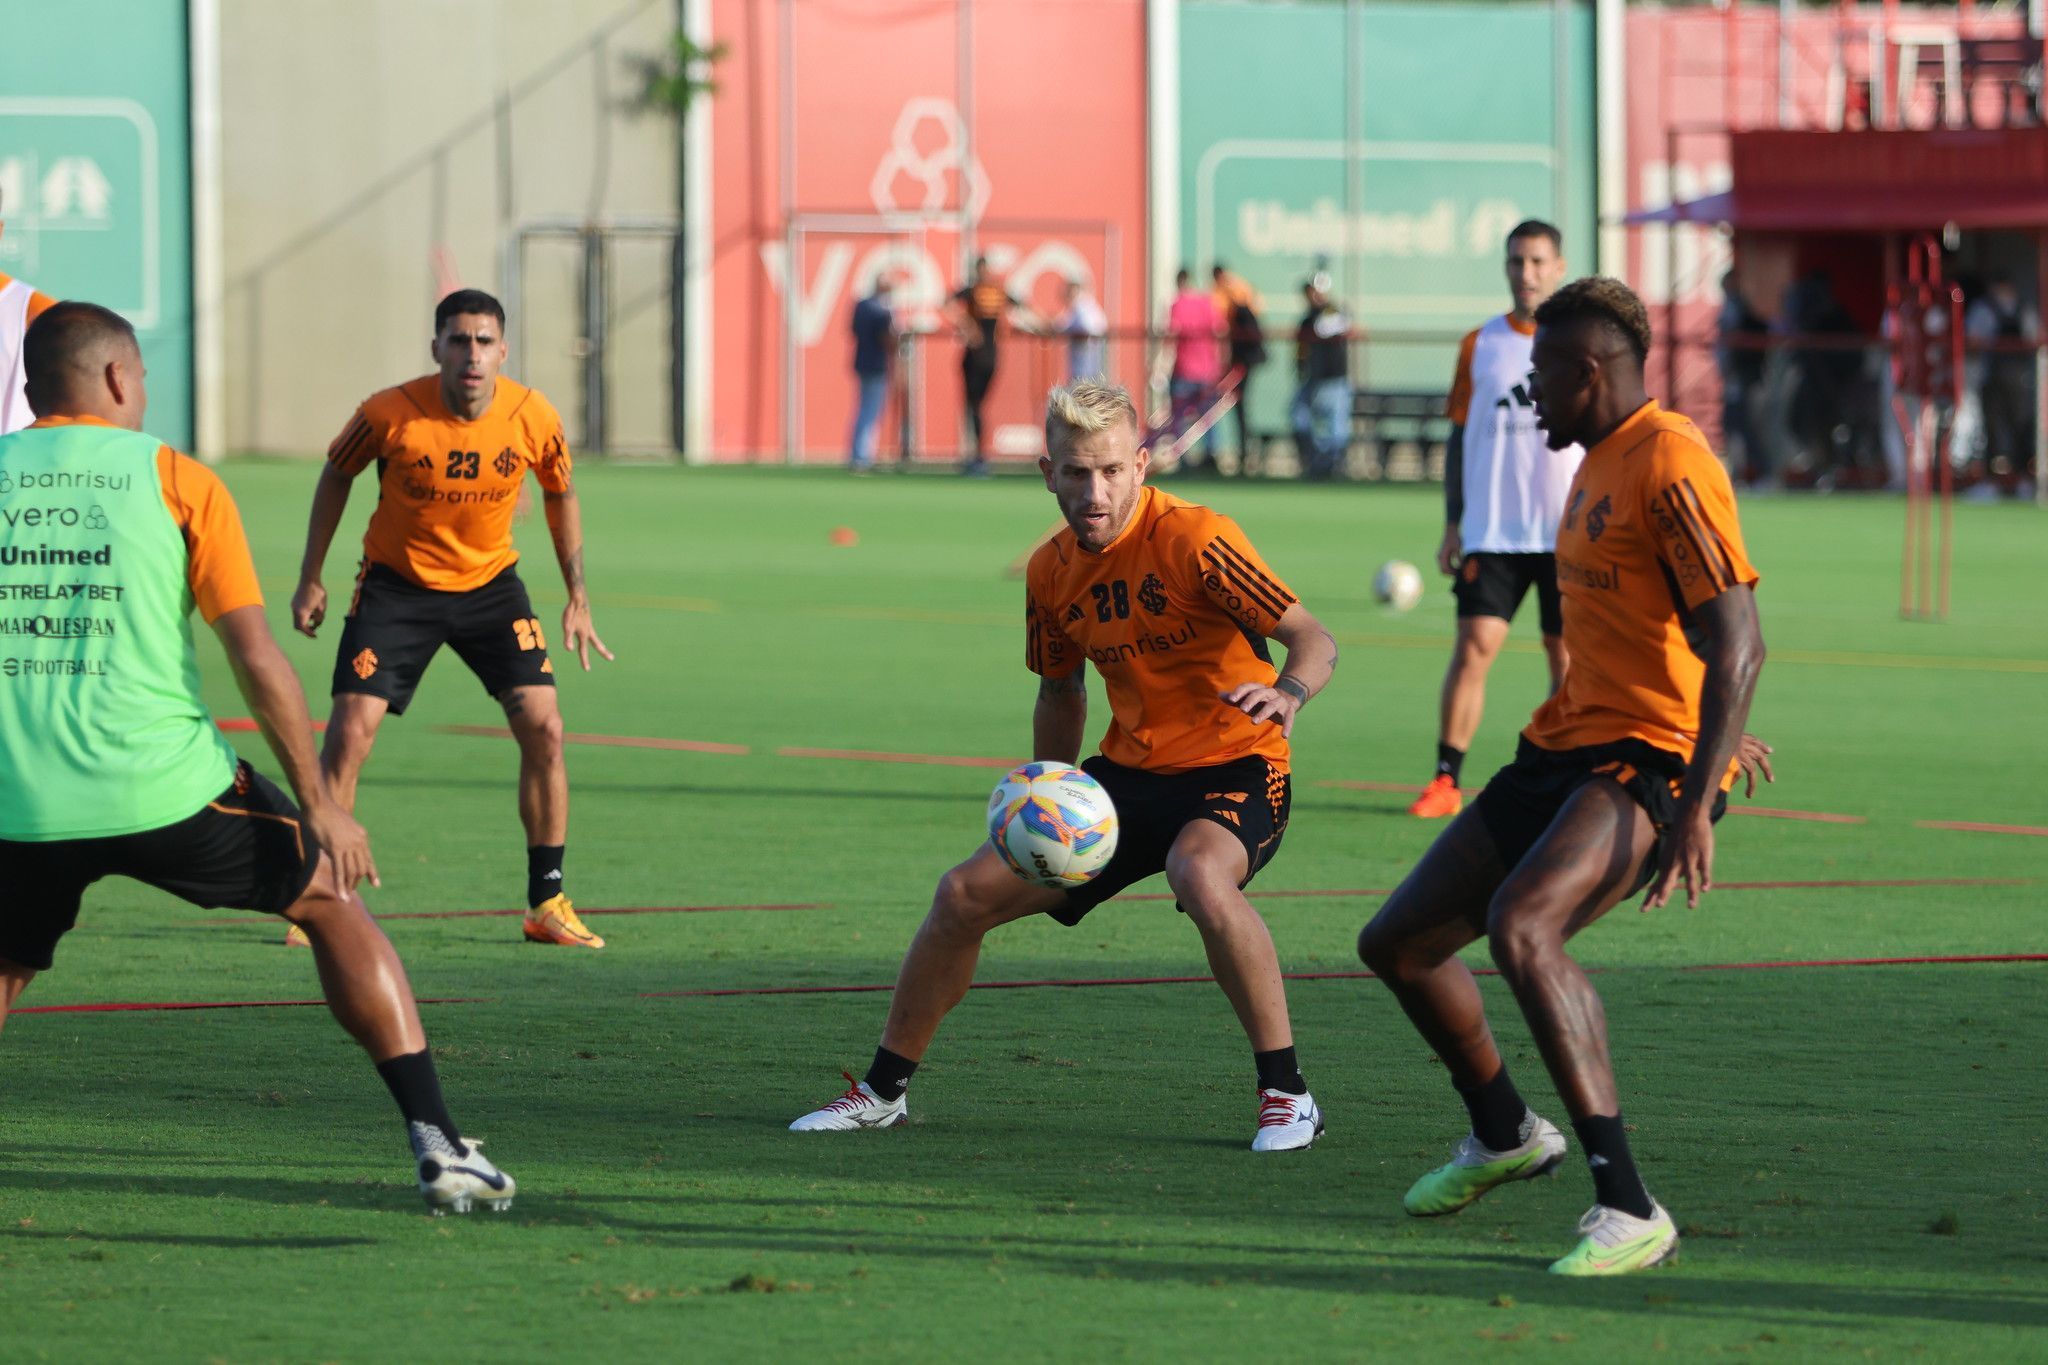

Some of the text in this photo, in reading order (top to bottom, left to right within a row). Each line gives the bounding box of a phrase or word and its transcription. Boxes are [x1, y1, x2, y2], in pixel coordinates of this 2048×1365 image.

[1238, 198, 1456, 256] Unimed
[446, 450, 480, 479] 23
[20, 470, 131, 491] banrisul
[3, 507, 79, 528] vero
[0, 543, 112, 566] Unimed
[1090, 579, 1130, 624] 28
[1089, 619, 1198, 664] banrisul
